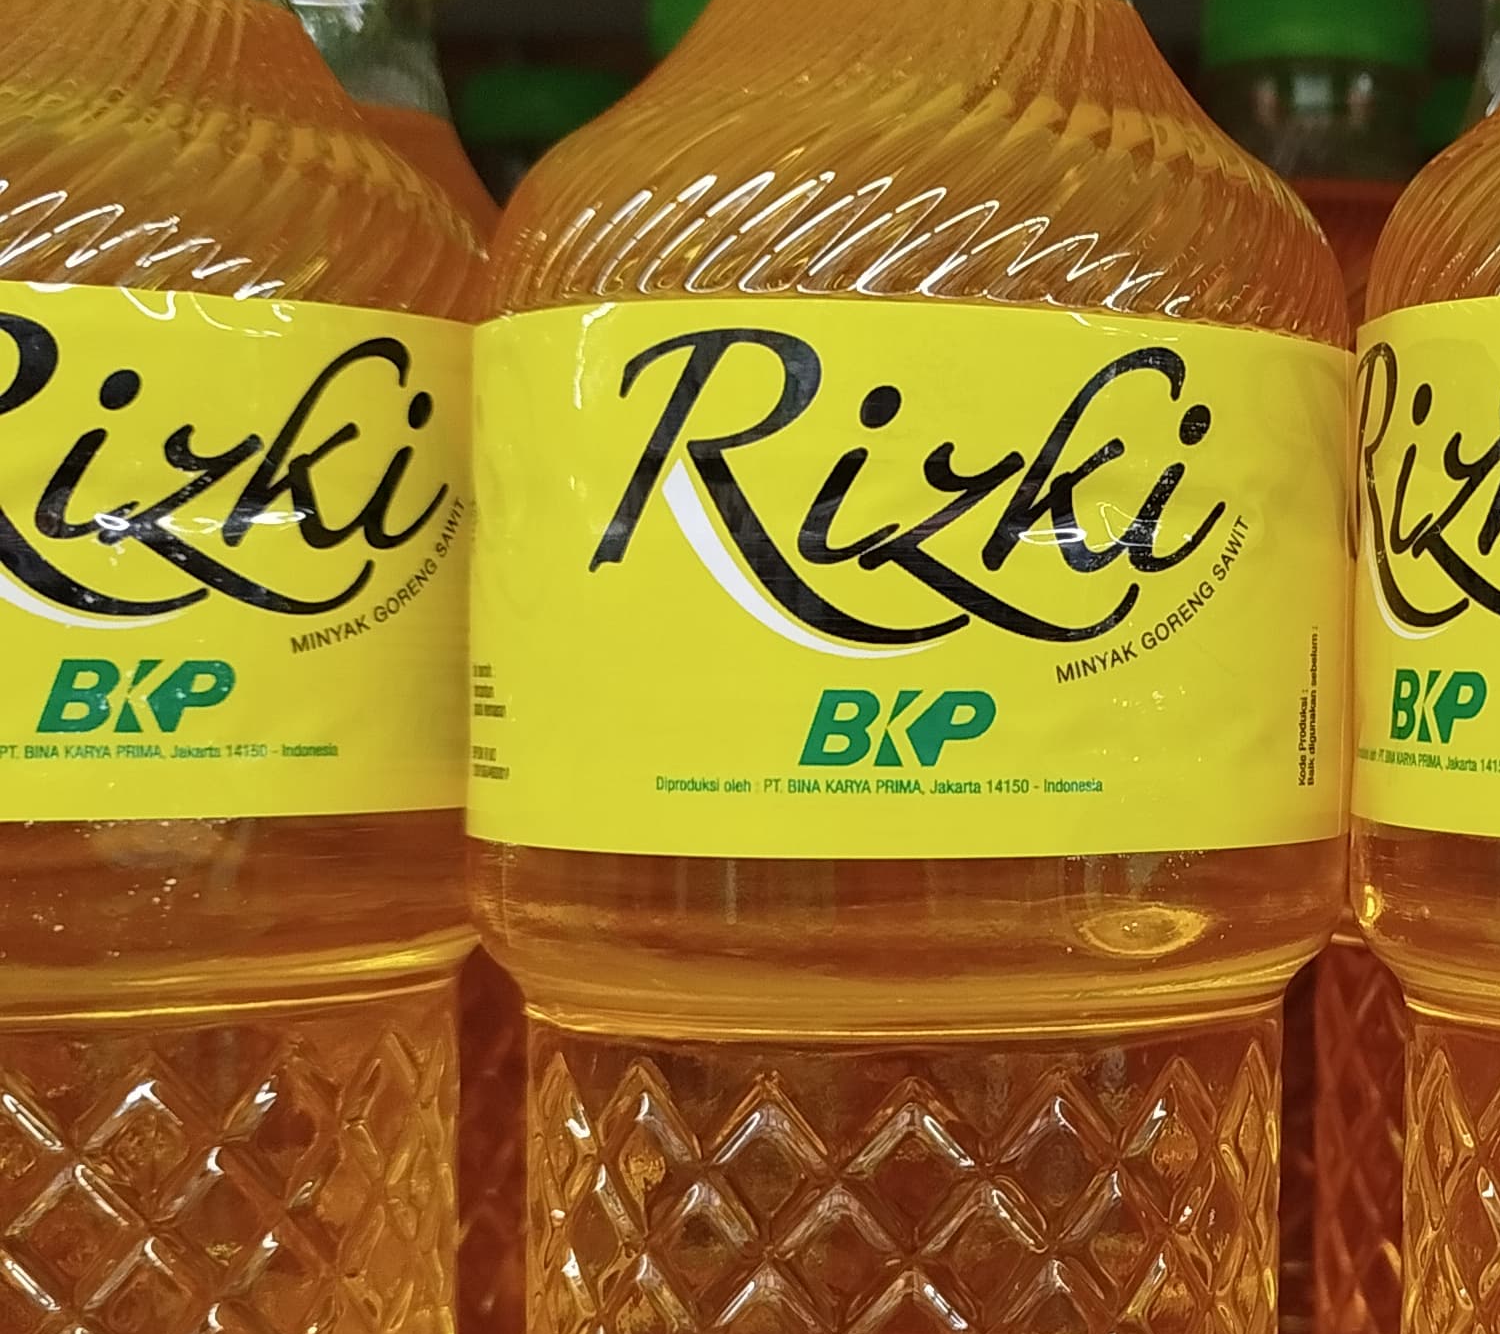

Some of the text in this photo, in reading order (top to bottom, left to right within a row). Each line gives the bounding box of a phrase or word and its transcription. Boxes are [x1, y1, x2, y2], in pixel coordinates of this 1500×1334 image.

[588, 328, 1226, 644] Rizki
[291, 497, 465, 653] MINYAK GORENG SAWIT
[1056, 515, 1249, 684] MINYAK GORENG SAWIT
[36, 659, 235, 733] BKP
[799, 689, 997, 767] BKP
[1391, 668, 1487, 744] BKP
[24, 745, 59, 759] BINA
[64, 745, 112, 759] KARYA
[655, 776, 719, 793] Diproduksi
[723, 778, 751, 793] oleh
[763, 778, 783, 793] PT.
[787, 779, 821, 794] BINA
[825, 779, 871, 794] KARYA
[875, 779, 925, 795] PRIMA,
[930, 779, 982, 794] Jakarta
[987, 779, 1029, 794] 14150
[1043, 778, 1103, 793] Indonesia
[1445, 756, 1478, 772] Jakarta
